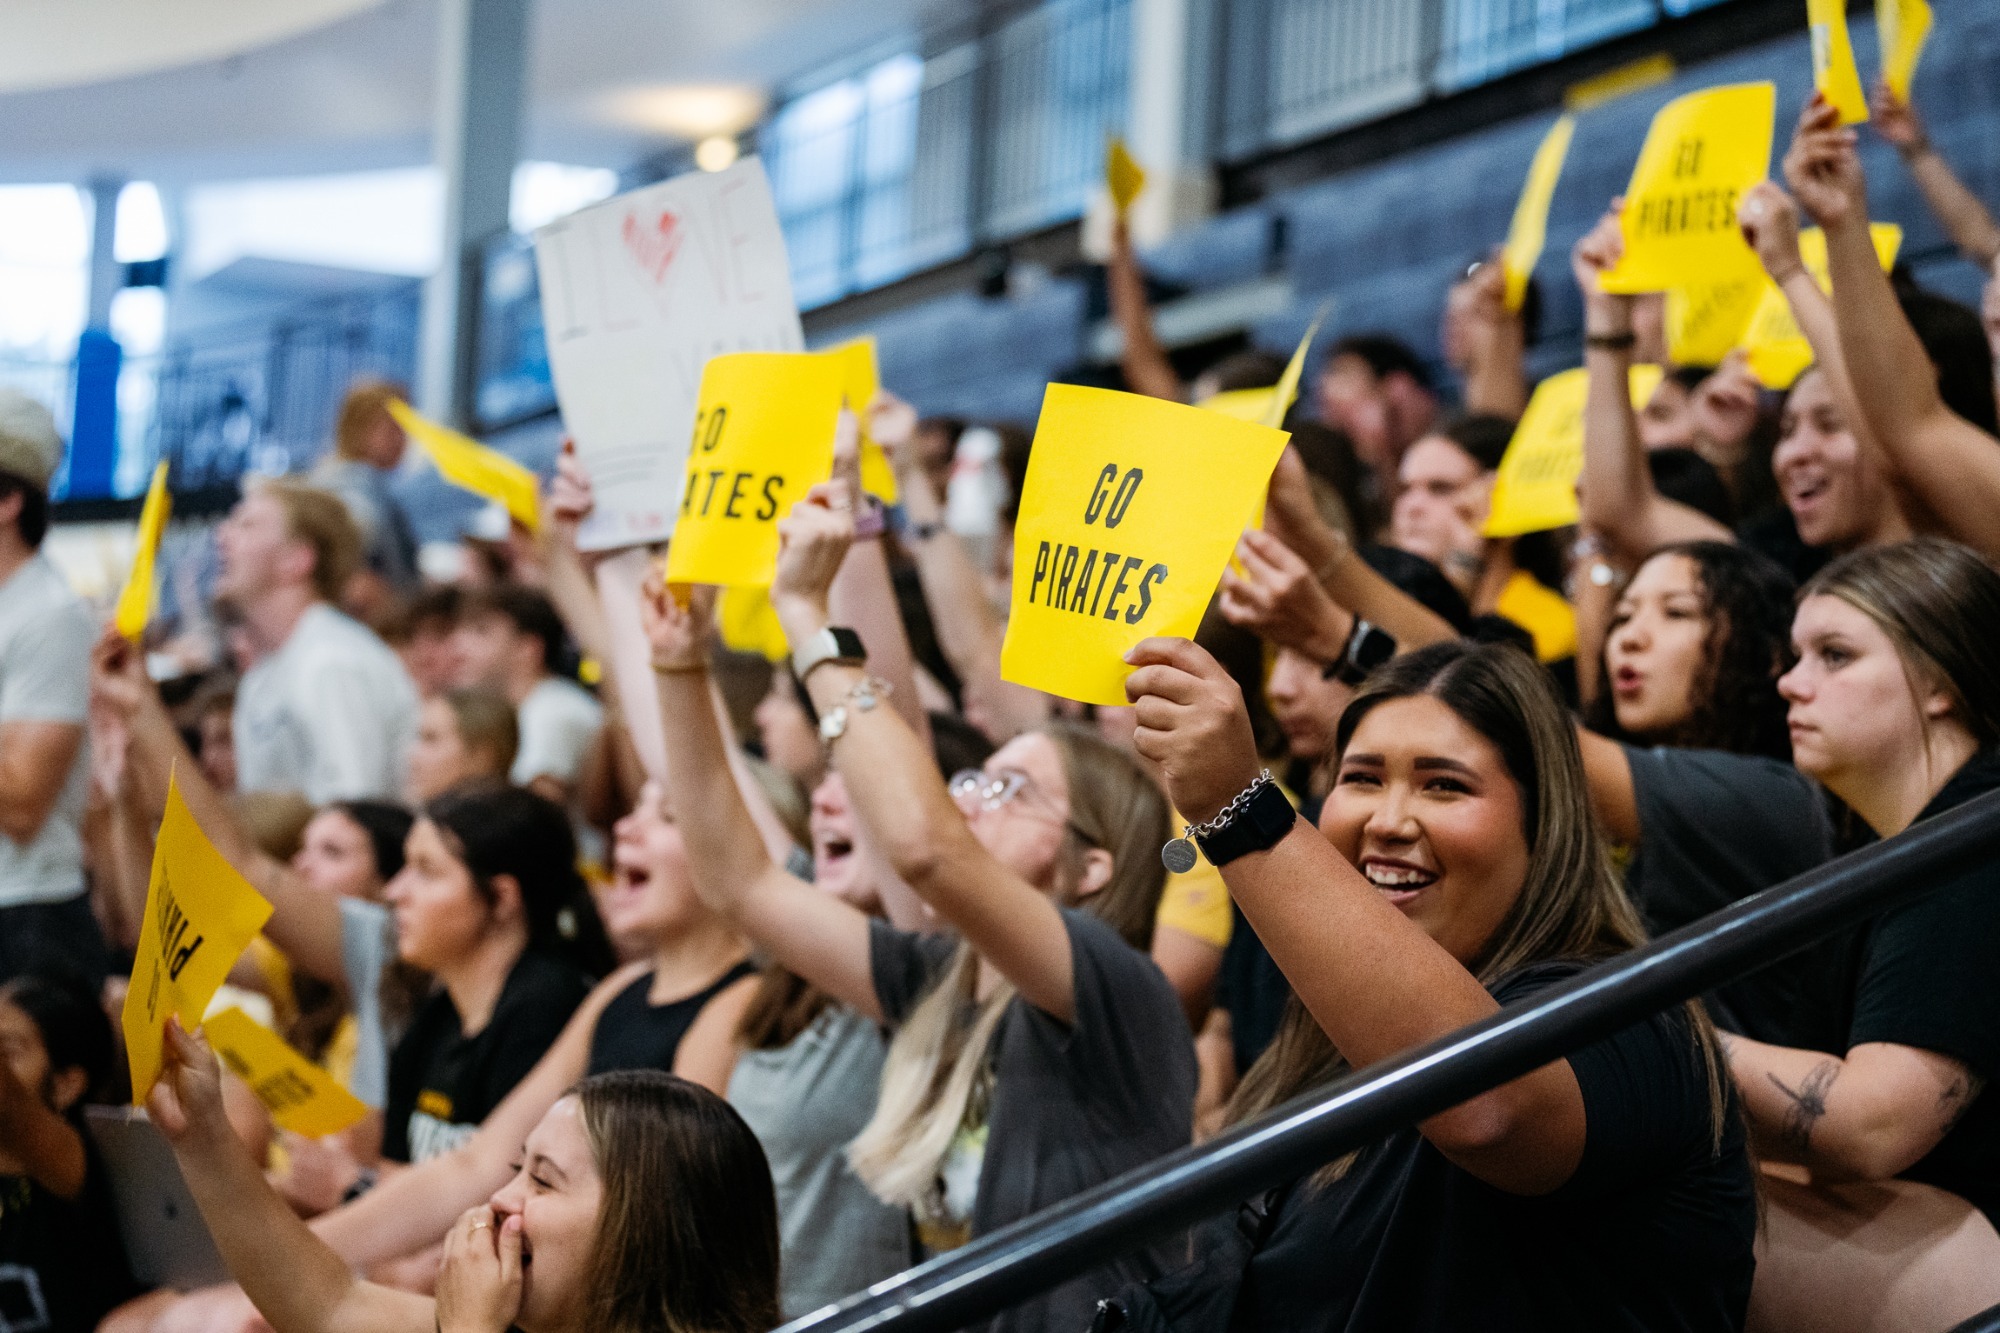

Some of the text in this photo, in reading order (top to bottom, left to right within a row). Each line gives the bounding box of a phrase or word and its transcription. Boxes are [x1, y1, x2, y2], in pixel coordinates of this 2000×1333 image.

[588, 177, 767, 332] LVE
[1084, 463, 1144, 529] GO
[1029, 540, 1168, 625] PIRATES
